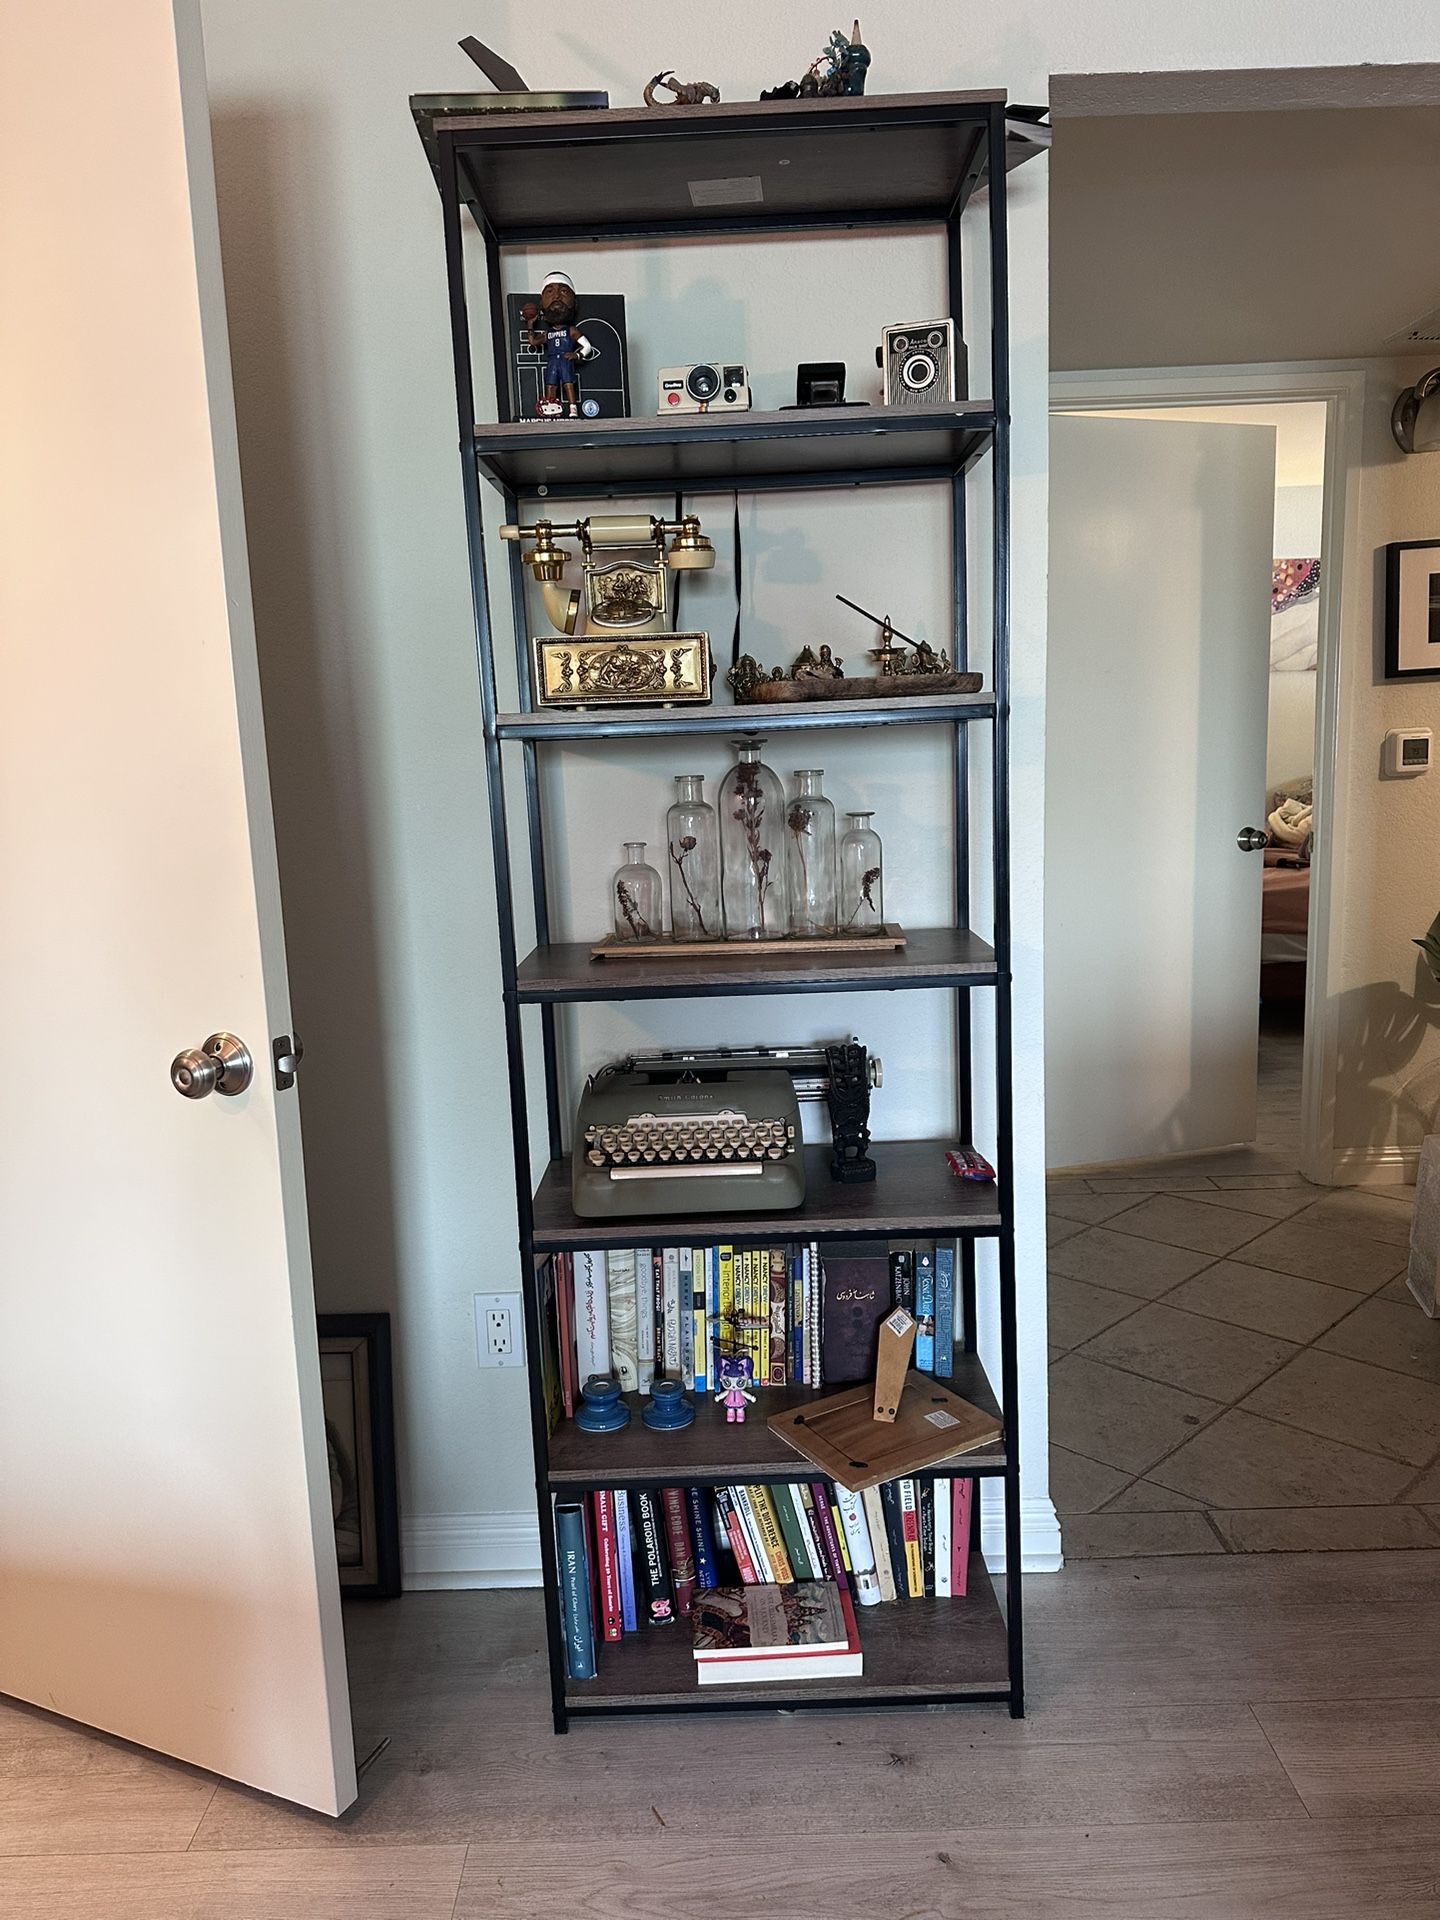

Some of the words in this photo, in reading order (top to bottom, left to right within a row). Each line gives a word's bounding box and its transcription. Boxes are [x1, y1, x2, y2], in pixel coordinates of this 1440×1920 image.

[547, 330, 567, 340] CLIPPERS
[555, 338, 560, 347] 8
[722, 1270, 732, 1301] Interior
[836, 1288, 853, 1301] فردوسی
[895, 1266, 903, 1306] KATZENBAC
[903, 1278, 911, 1296] JOHN
[721, 1302, 732, 1330] Desn
[753, 1485, 764, 1498] PLIT
[903, 1480, 911, 1490] YD
[599, 1490, 607, 1514] SMALL
[639, 1493, 650, 1518] BOOK
[668, 1490, 679, 1513] VINCI
[738, 1490, 751, 1516] BANKROLL
[758, 1500, 768, 1512] THE
[904, 1490, 913, 1510] FIELD
[692, 1499, 702, 1525] SHINE
[670, 1515, 683, 1536] CODE
[762, 1512, 780, 1548] DIFFERENCE
[643, 1521, 657, 1566] POLAROID
[696, 1526, 705, 1552] SHINE
[674, 1541, 686, 1558] DAN
[776, 1551, 786, 1567] CHRIS
[824, 1525, 836, 1552] ADVENTURES
[834, 1559, 842, 1574] TINTIN
[566, 1551, 576, 1574] IRAN
[649, 1568, 660, 1586] THE
[698, 1569, 706, 1588] NETZE
[704, 1571, 712, 1587] LYDI
[780, 1566, 790, 1580] VOSS
[573, 1635, 584, 1652] ایران
